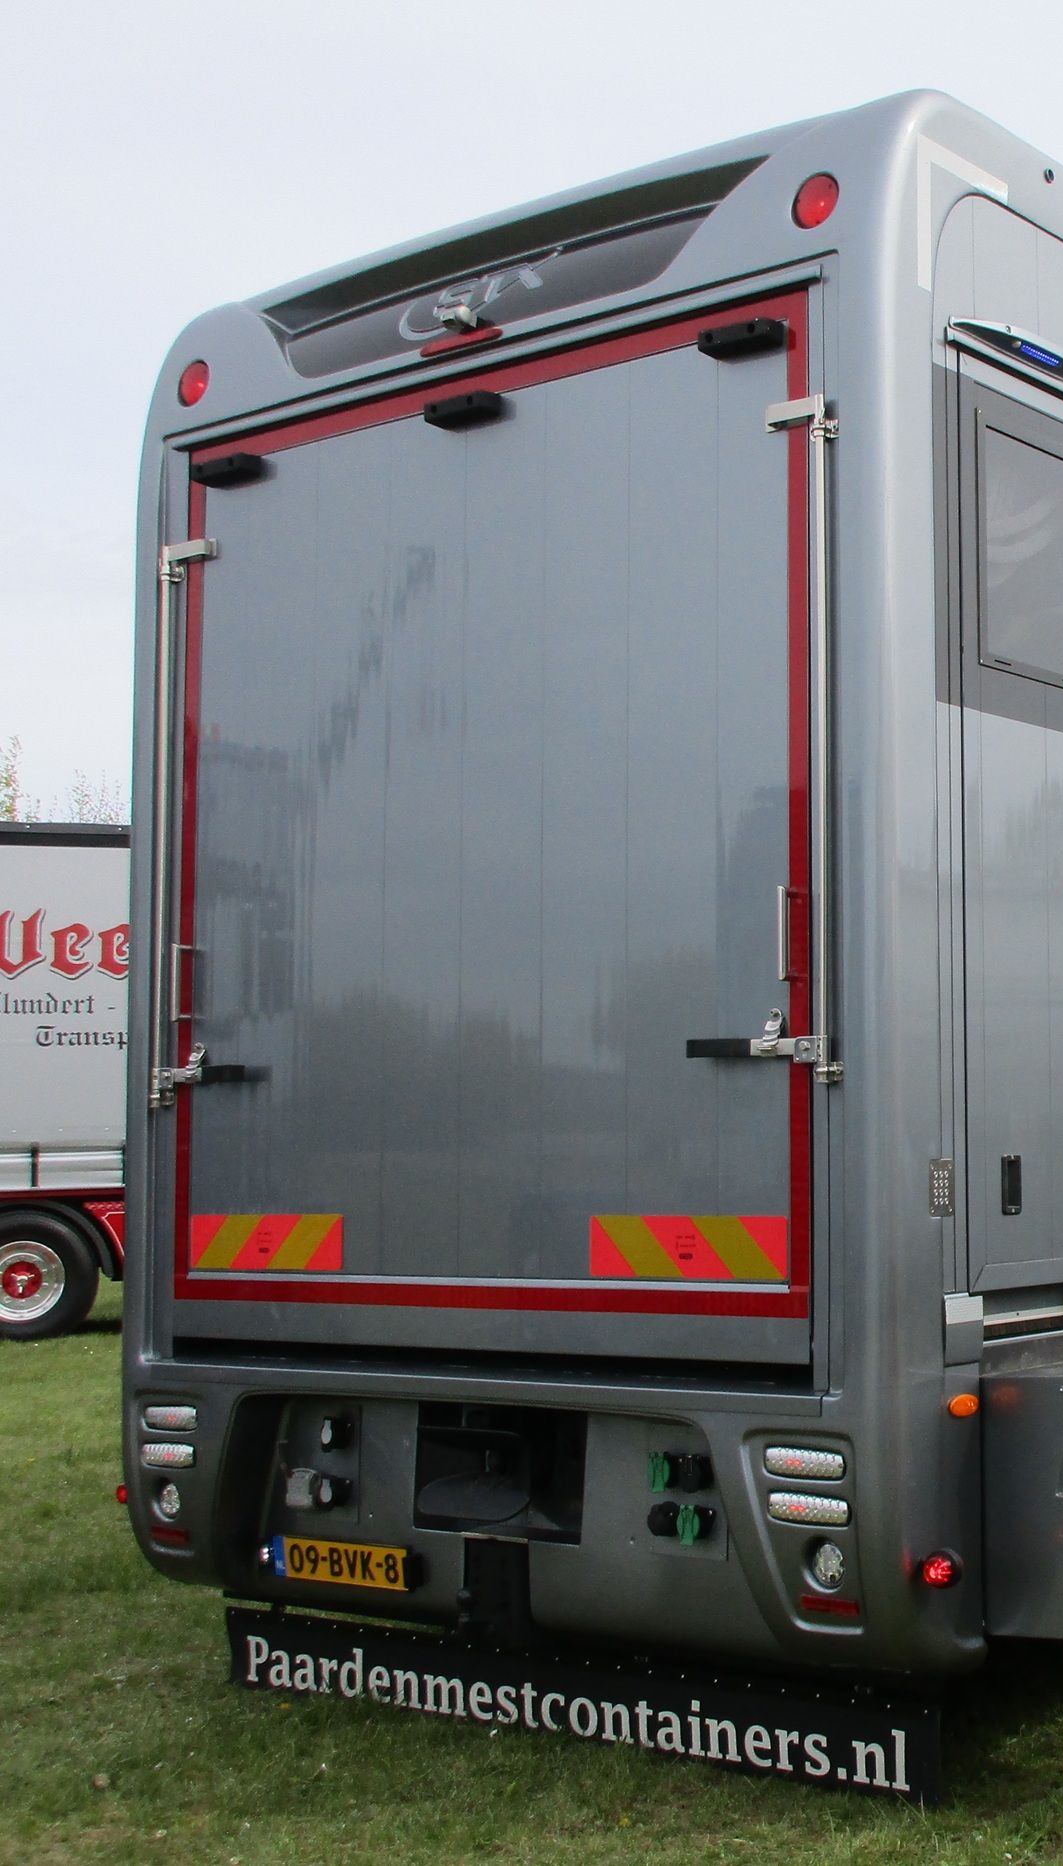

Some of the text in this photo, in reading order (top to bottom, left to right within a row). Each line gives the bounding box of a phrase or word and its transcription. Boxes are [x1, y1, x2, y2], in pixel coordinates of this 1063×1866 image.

[0, 992, 94, 1015] lundert
[289, 1543, 400, 1584] 09-BVK-8
[246, 1635, 910, 1793] Paardenmestcontainers.nl
